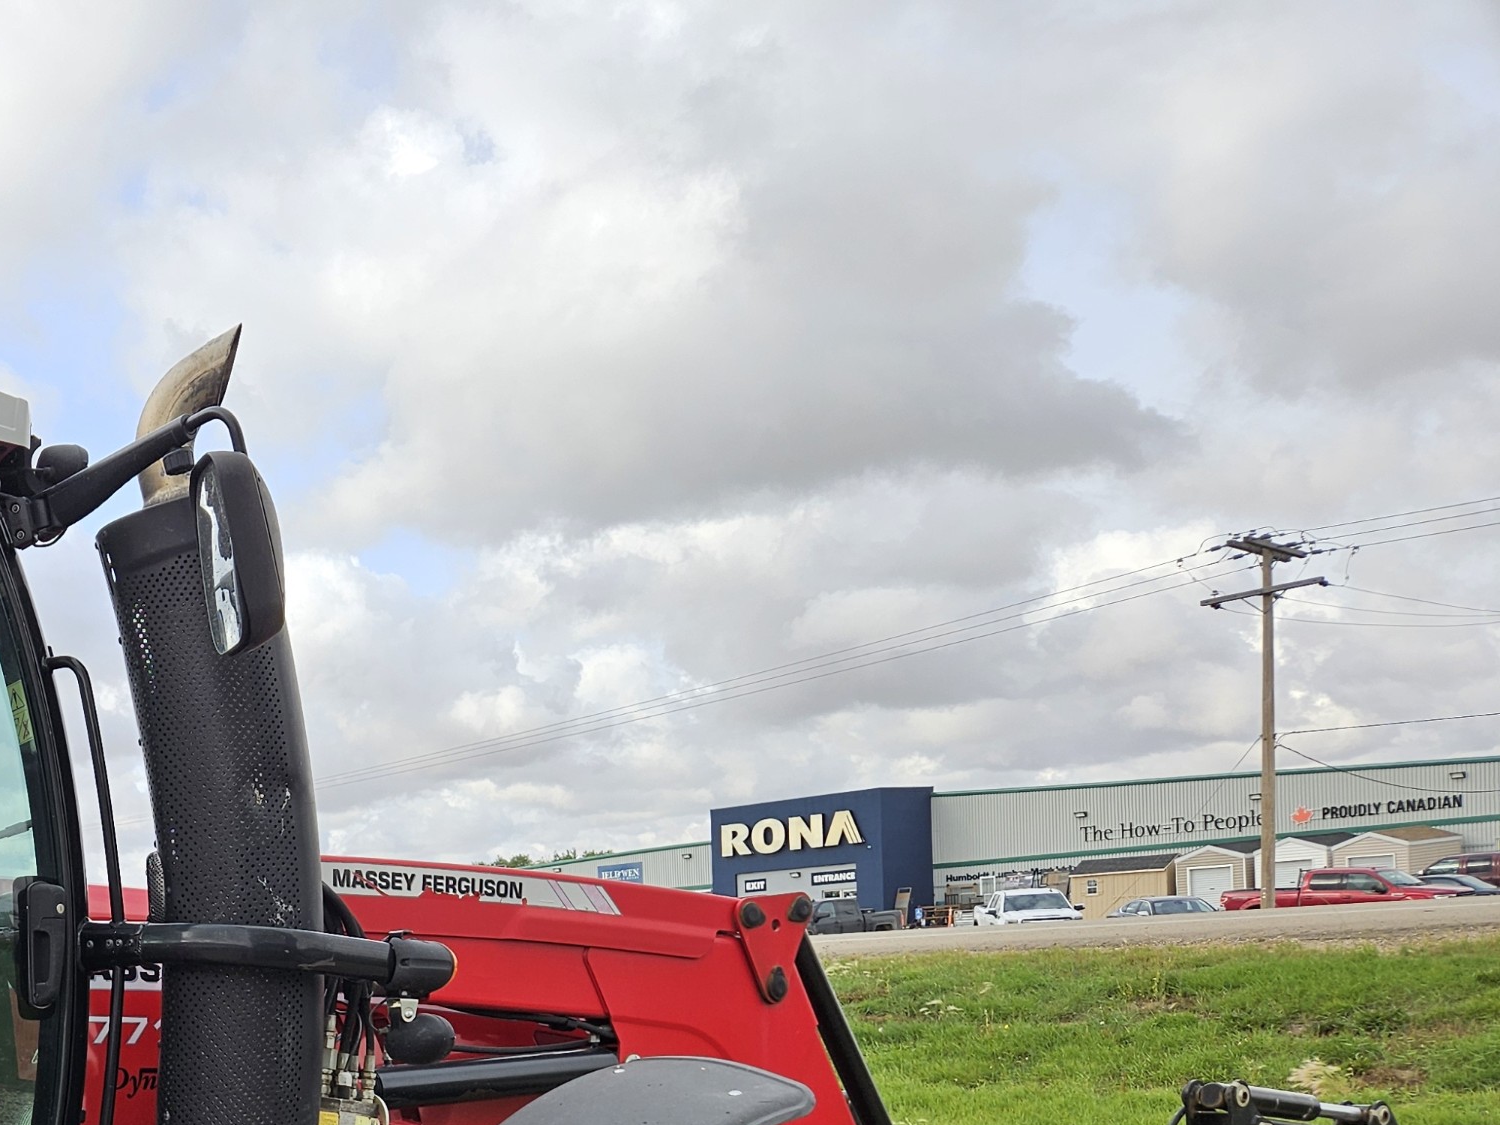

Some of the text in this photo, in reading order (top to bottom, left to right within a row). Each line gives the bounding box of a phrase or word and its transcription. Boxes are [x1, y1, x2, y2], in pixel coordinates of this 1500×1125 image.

[1322, 794, 1463, 819] PROUDLY CANADIAN
[720, 810, 865, 858] RONA
[1080, 826, 1113, 842] The
[1121, 816, 1195, 839] How-To
[332, 868, 523, 900] MASSEY FERGUSON
[746, 881, 766, 890] EXIT
[813, 872, 856, 883] ENTRANCE
